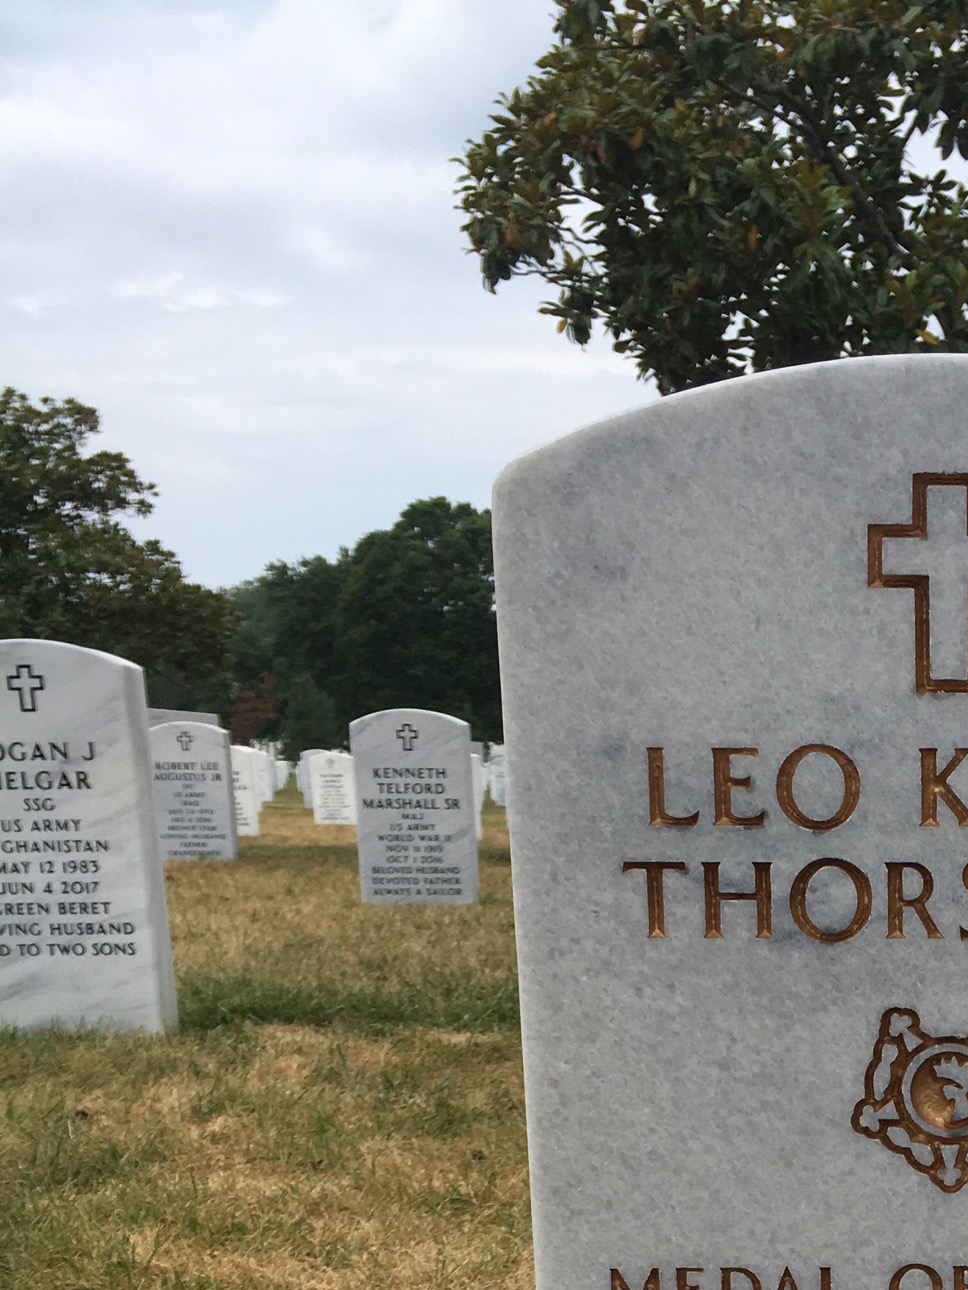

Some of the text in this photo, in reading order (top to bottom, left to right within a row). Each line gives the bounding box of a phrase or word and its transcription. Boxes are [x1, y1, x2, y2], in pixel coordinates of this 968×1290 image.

[0, 741, 96, 762] GAN J
[155, 761, 219, 770] ROBERT LEE
[0, 770, 92, 790] ELGAR
[153, 772, 222, 781] AUGUSTUS JR
[372, 767, 447, 779] KENNETH
[377, 782, 446, 795] TELFORD
[645, 743, 862, 833] LEO
[23, 797, 56, 812] SSG
[362, 798, 461, 810] MARSHALL SR
[1, 818, 82, 834] US ARMY
[407, 823, 436, 831] ARMY
[377, 834, 415, 842] WORLD
[418, 834, 440, 842] WAR
[0, 839, 109, 854] GHANISTAN
[39, 860, 55, 874] 12
[62, 860, 100, 874] 1983
[0, 881, 100, 895] JUN 4 2017
[0, 901, 111, 916] REEN BERET
[49, 922, 136, 936] HUSBAND
[16, 943, 41, 957] TO
[46, 943, 86, 957] TWO
[91, 942, 136, 956] SONS
